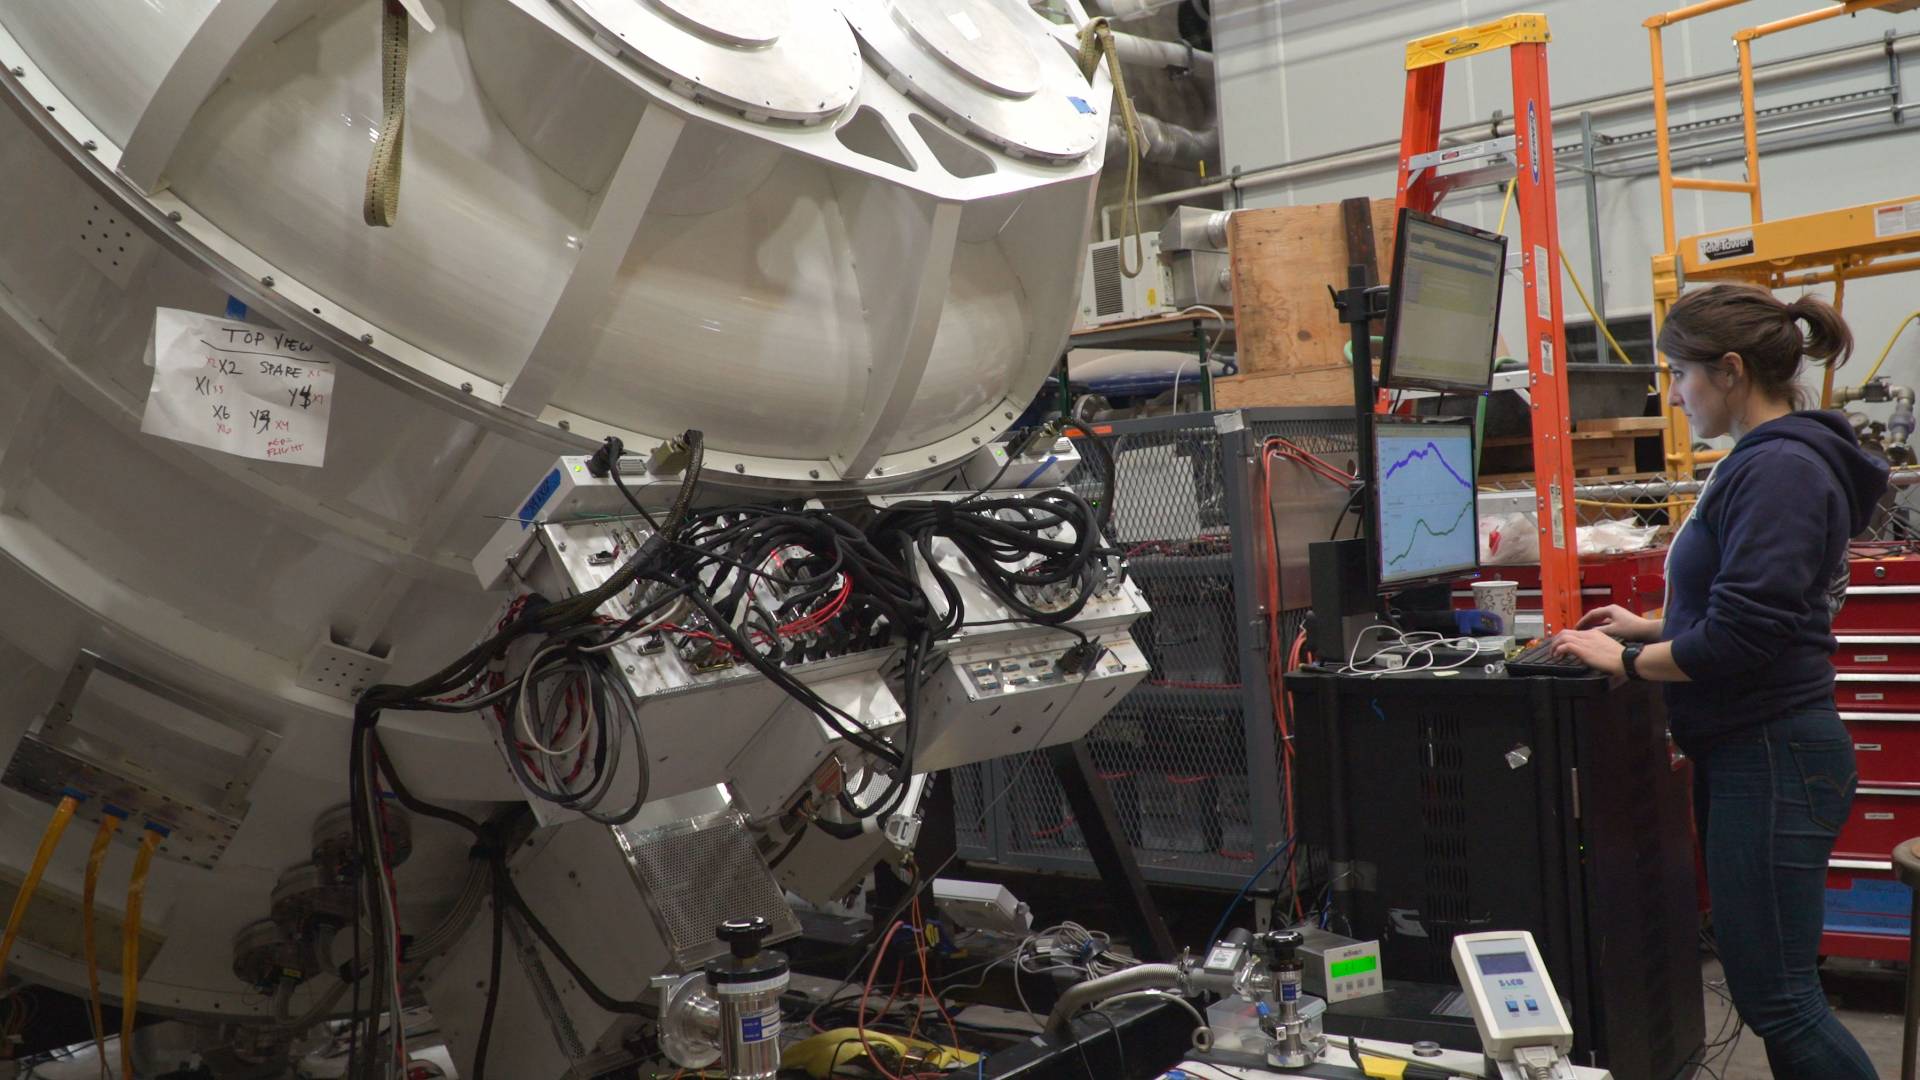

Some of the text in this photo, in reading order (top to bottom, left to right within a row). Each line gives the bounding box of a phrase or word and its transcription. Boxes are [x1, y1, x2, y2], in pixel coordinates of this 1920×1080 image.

[222, 328, 313, 352] TOP VIEW
[218, 359, 302, 378] X2 SPARE
[195, 376, 210, 395] X1
[213, 404, 231, 420] X6
